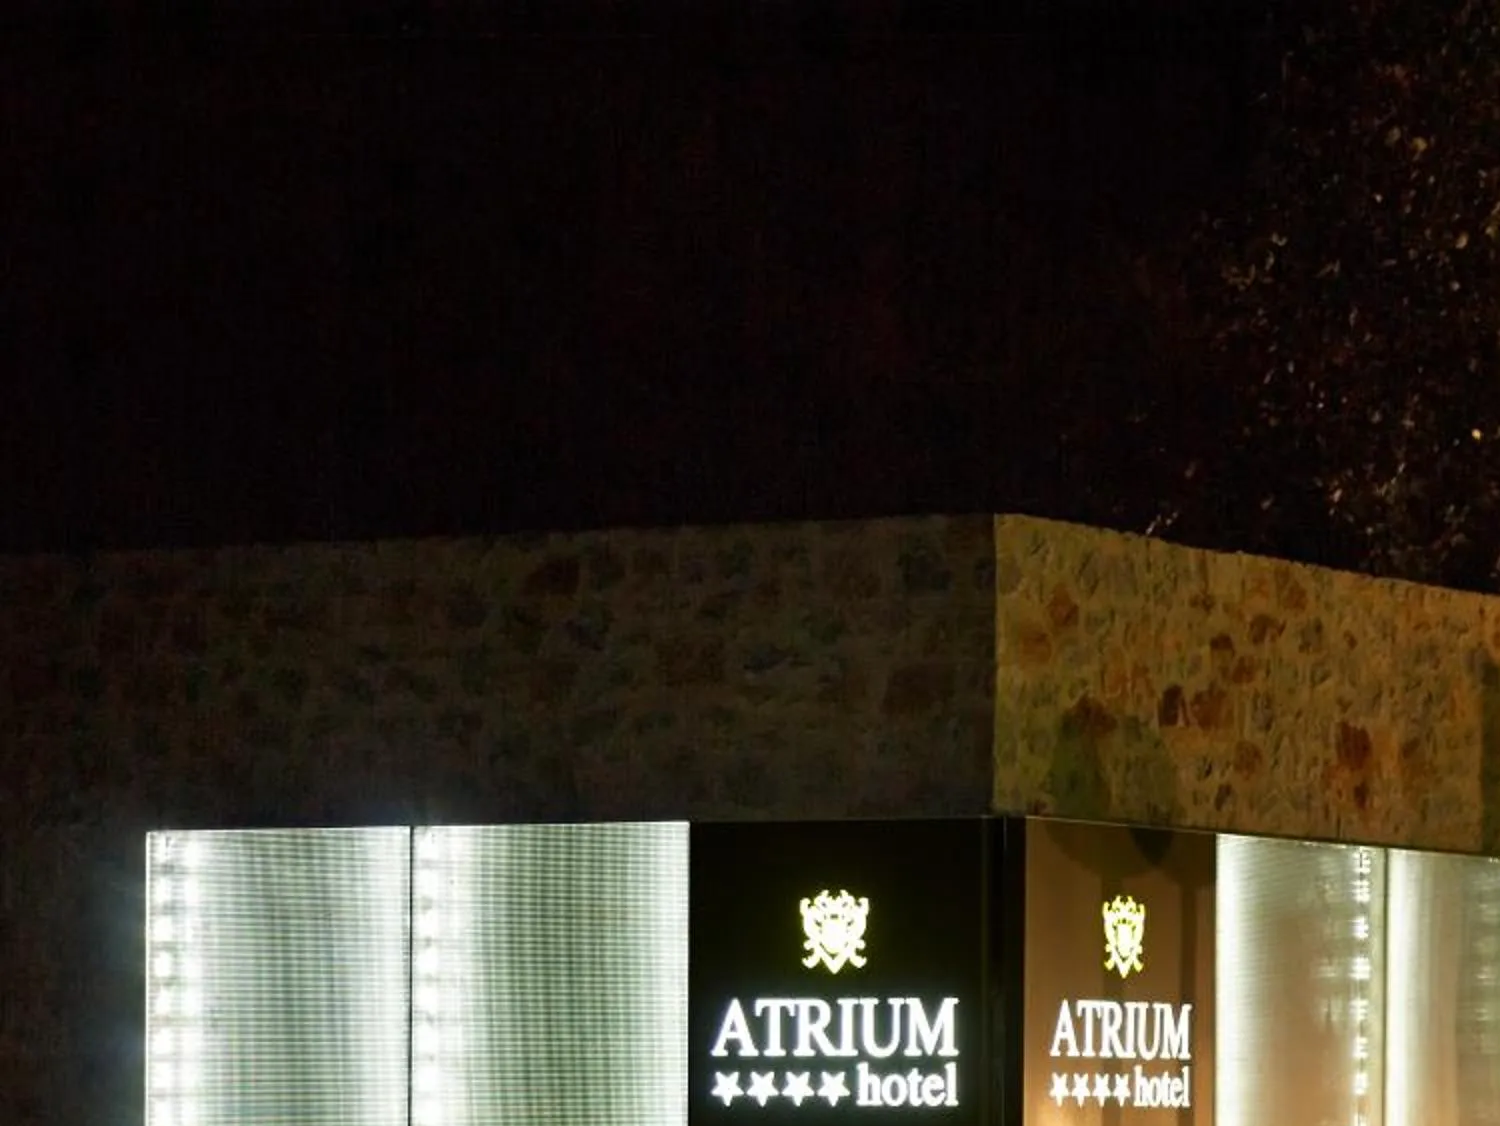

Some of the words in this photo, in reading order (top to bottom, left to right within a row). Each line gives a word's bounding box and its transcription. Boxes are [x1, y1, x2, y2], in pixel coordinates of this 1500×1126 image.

[711, 997, 959, 1057] ATRIUM
[1049, 998, 1192, 1060] ATRIUM
[856, 1061, 959, 1107] hotel
[1133, 1065, 1190, 1108] hotel
